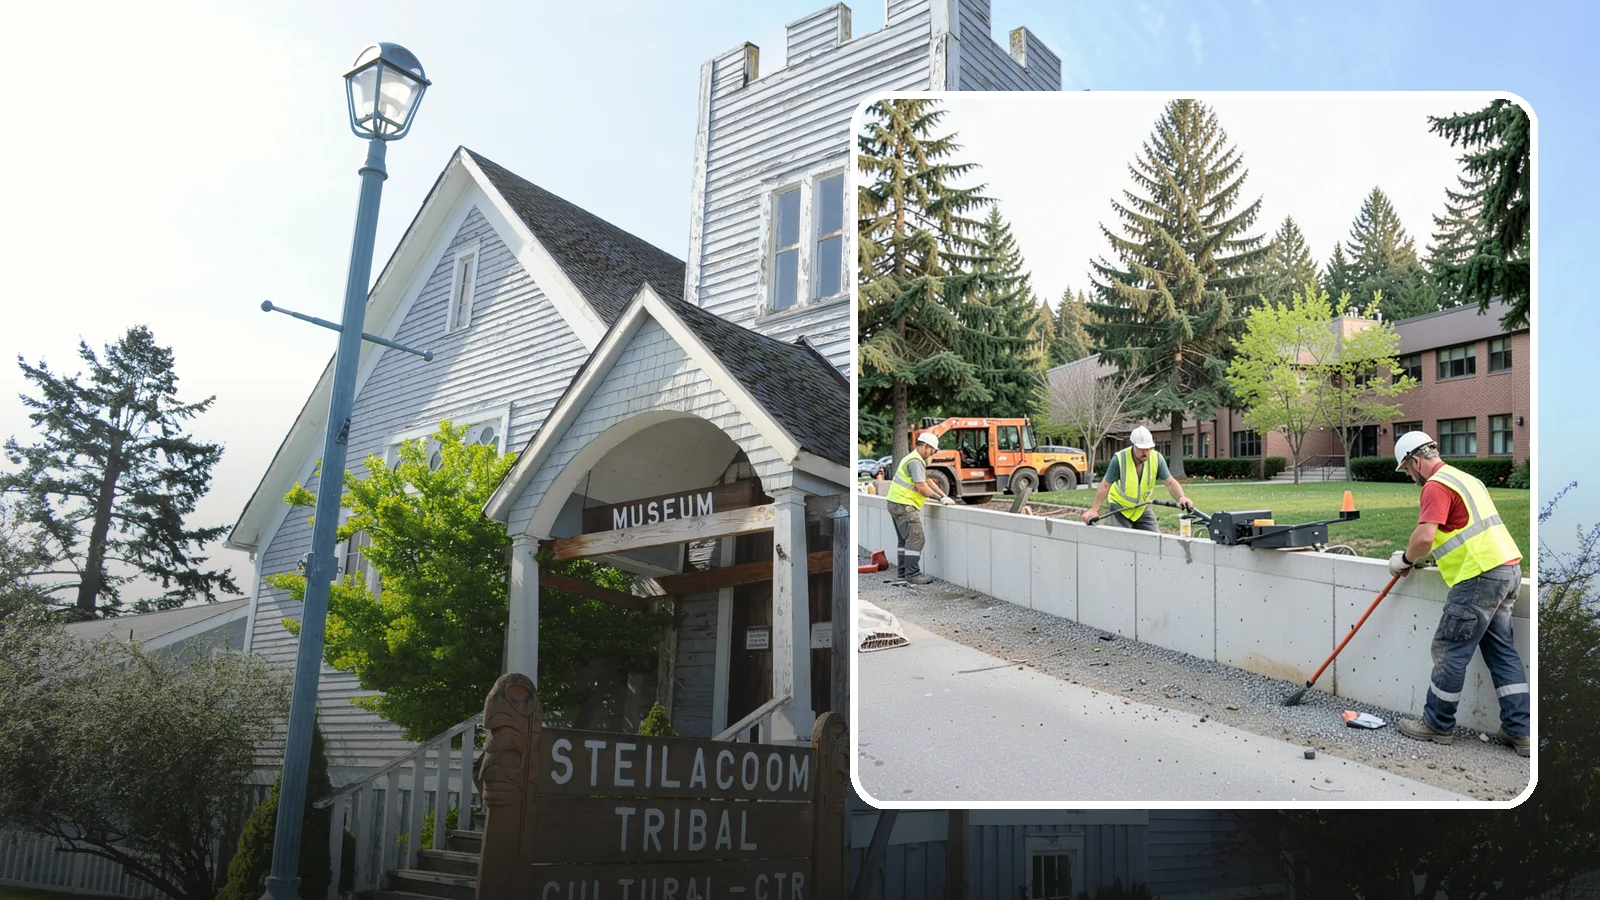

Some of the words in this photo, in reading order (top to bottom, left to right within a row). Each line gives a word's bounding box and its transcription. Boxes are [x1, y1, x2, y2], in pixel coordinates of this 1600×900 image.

[613, 491, 714, 531] MUSEUM
[551, 738, 810, 793] STEILACOOM
[614, 806, 758, 852] TRIBAL
[754, 871, 806, 900] CTR
